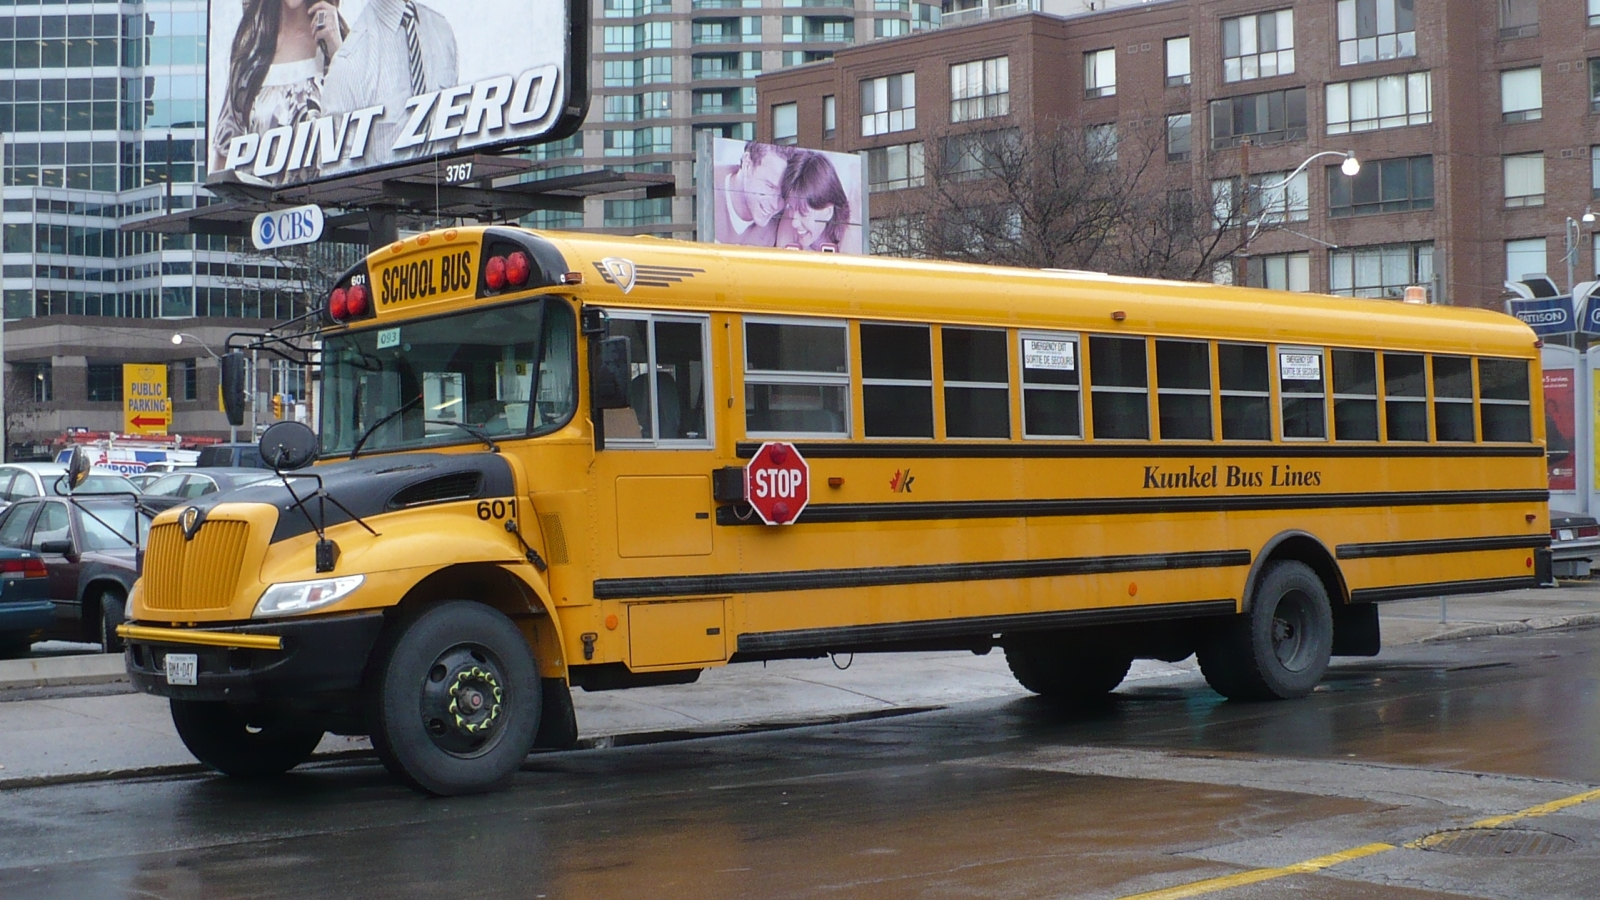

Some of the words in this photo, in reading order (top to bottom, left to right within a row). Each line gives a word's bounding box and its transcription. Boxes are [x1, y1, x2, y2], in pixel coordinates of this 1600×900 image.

[224, 105, 384, 177] POINT
[392, 64, 558, 150] ZERO
[446, 162, 473, 183] 3767
[277, 208, 314, 242] CBS
[351, 274, 366, 286] 601
[381, 259, 437, 305] SCHOOL
[441, 250, 471, 293] BUS
[1518, 311, 1562, 323] PATTISON
[380, 332, 397, 344] 093
[1031, 341, 1057, 351] EMERGENCY
[1025, 354, 1043, 364] SORTIE
[1044, 355, 1050, 365] DE
[1051, 355, 1074, 366] SECOURS
[131, 382, 162, 396] PUBLIC
[128, 399, 166, 413] PARKING
[755, 468, 802, 498] STOP
[1142, 465, 1218, 489] Kunkel
[1225, 465, 1263, 487] Bus
[1270, 464, 1322, 487] Lines
[476, 498, 518, 520] 601
